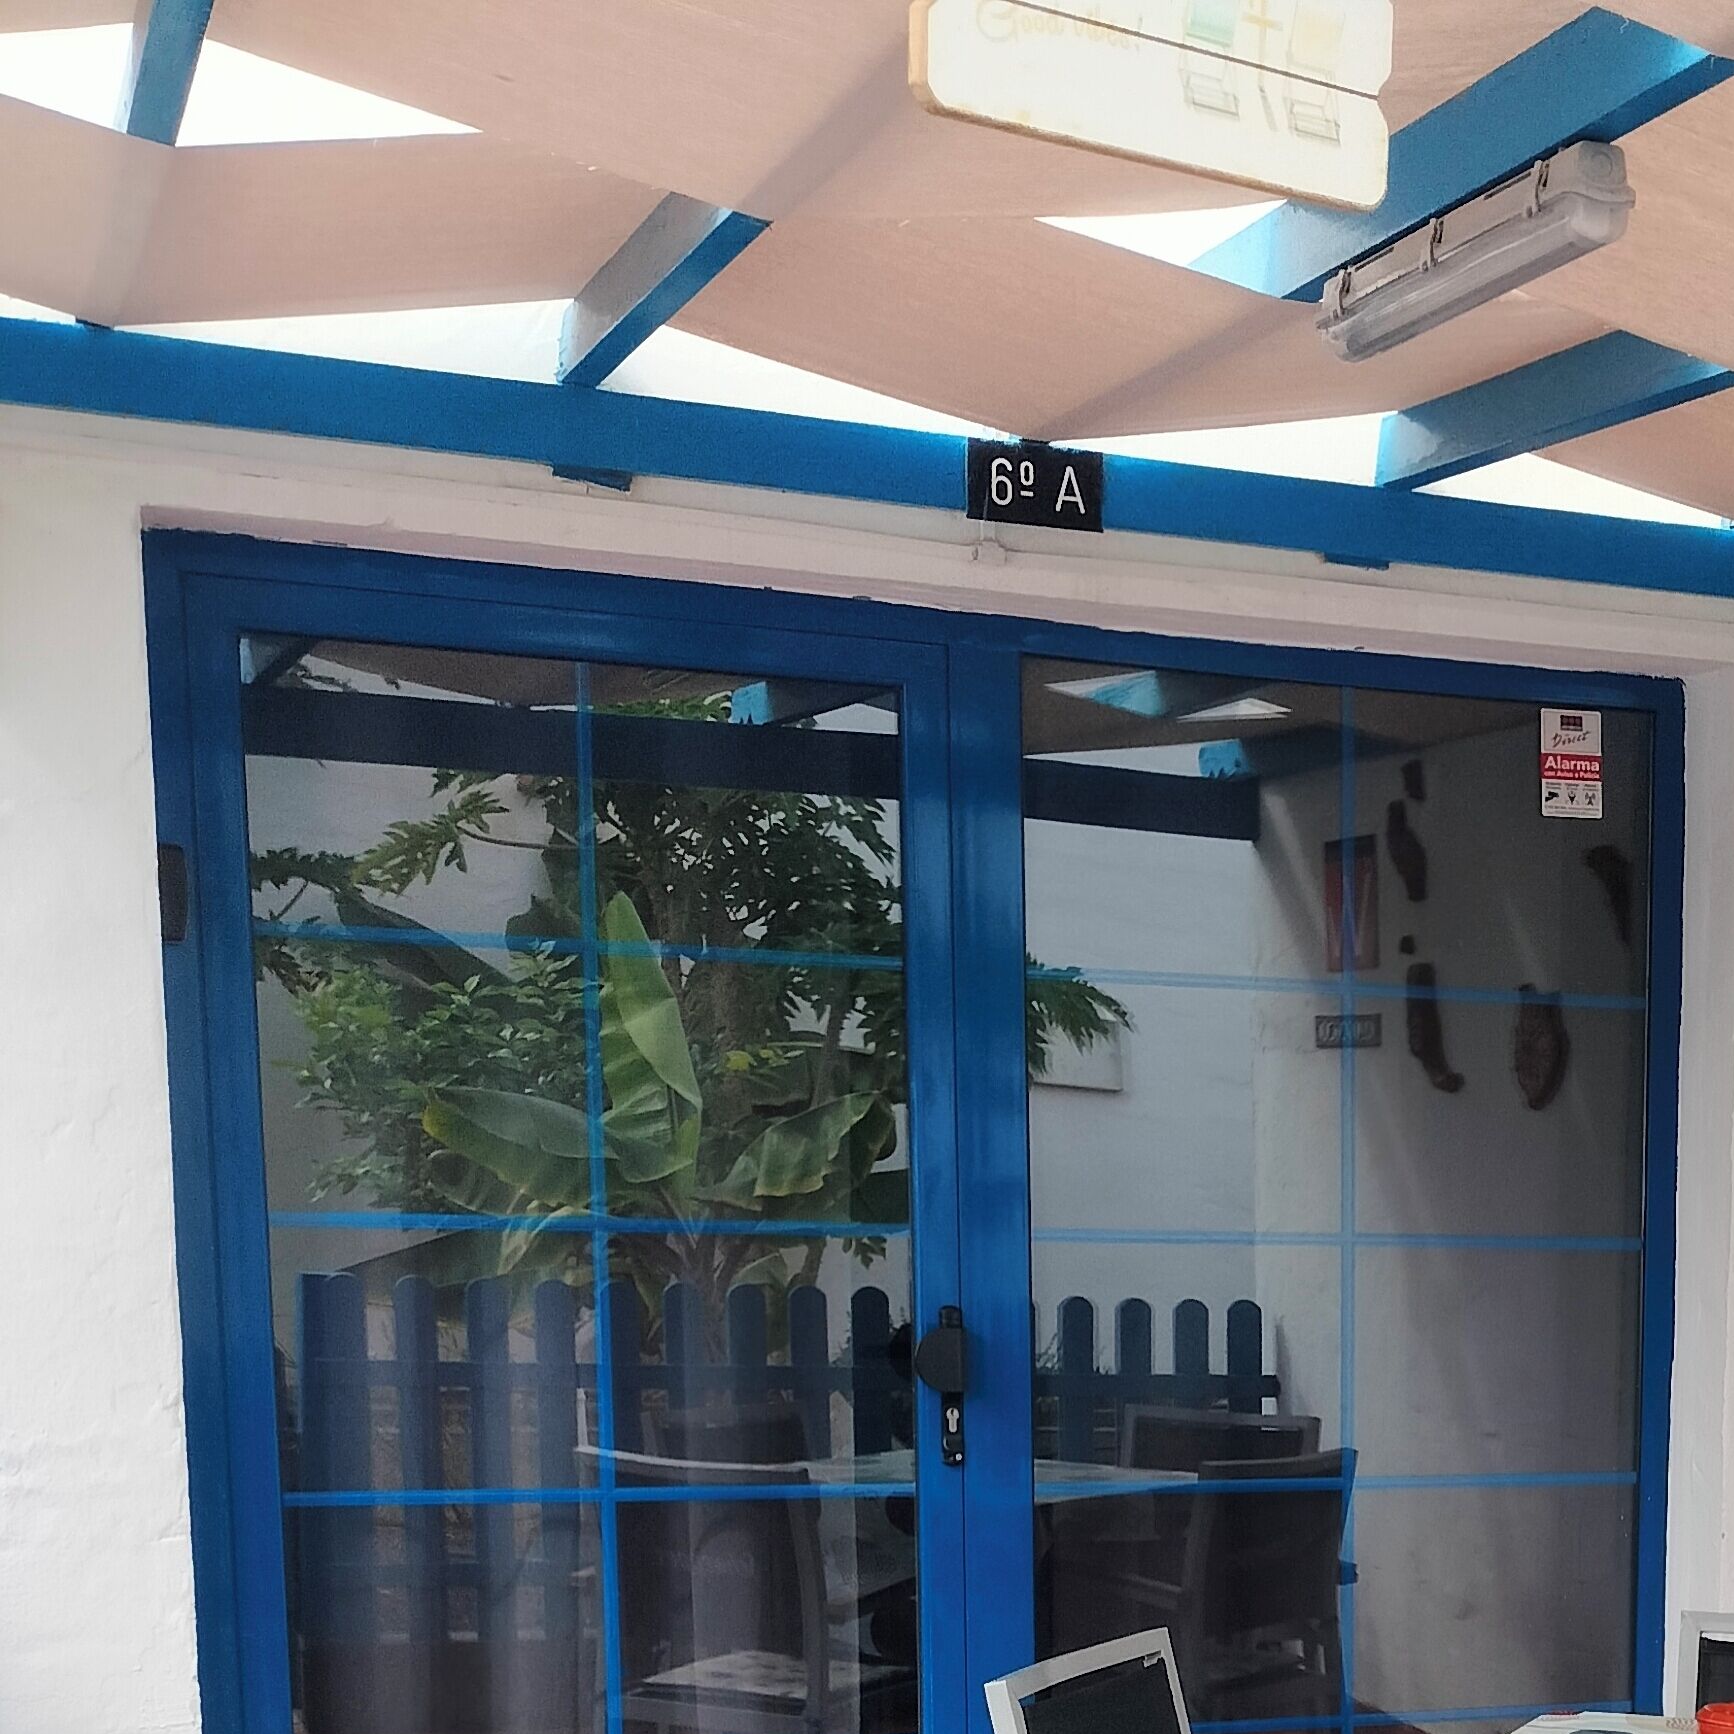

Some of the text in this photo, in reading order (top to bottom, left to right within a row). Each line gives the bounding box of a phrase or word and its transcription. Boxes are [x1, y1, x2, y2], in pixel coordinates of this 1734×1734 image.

[990, 457, 1086, 515] 6º A
[1544, 755, 1600, 771] Alarma
